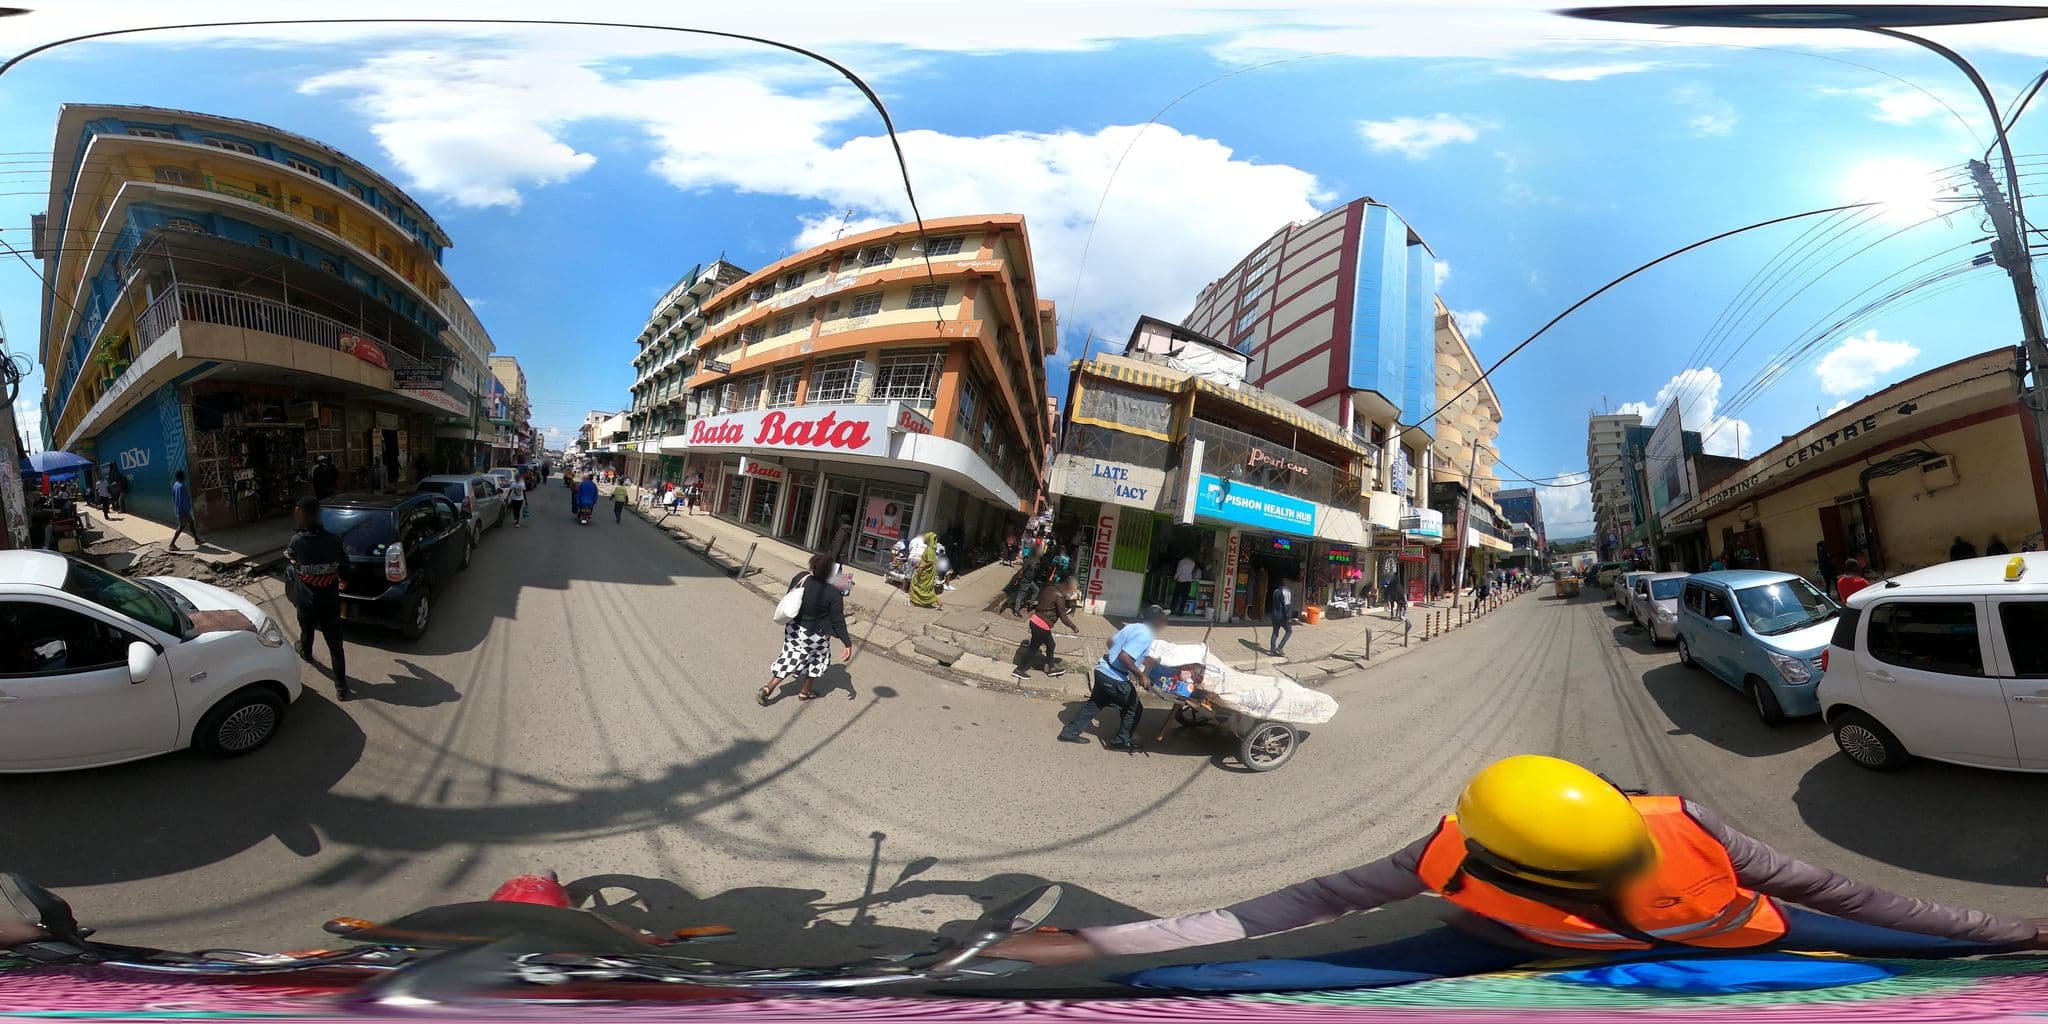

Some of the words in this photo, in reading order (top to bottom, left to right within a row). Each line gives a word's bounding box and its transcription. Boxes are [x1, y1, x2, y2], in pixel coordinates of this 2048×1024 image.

[690, 419, 744, 445] Bata
[754, 410, 871, 450] Bata
[899, 410, 931, 435] Bata
[119, 447, 151, 471] DStv
[745, 462, 782, 479] Bata
[1247, 447, 1286, 469] Pearl
[1706, 475, 1760, 506] SHOPPING
[1785, 414, 1877, 468] CENTRE
[1092, 463, 1129, 481] LATE
[1225, 494, 1262, 511] PISHON
[1263, 503, 1295, 519] HEALTH
[1296, 511, 1312, 523] HUB
[1088, 516, 1113, 606] CHEMIST
